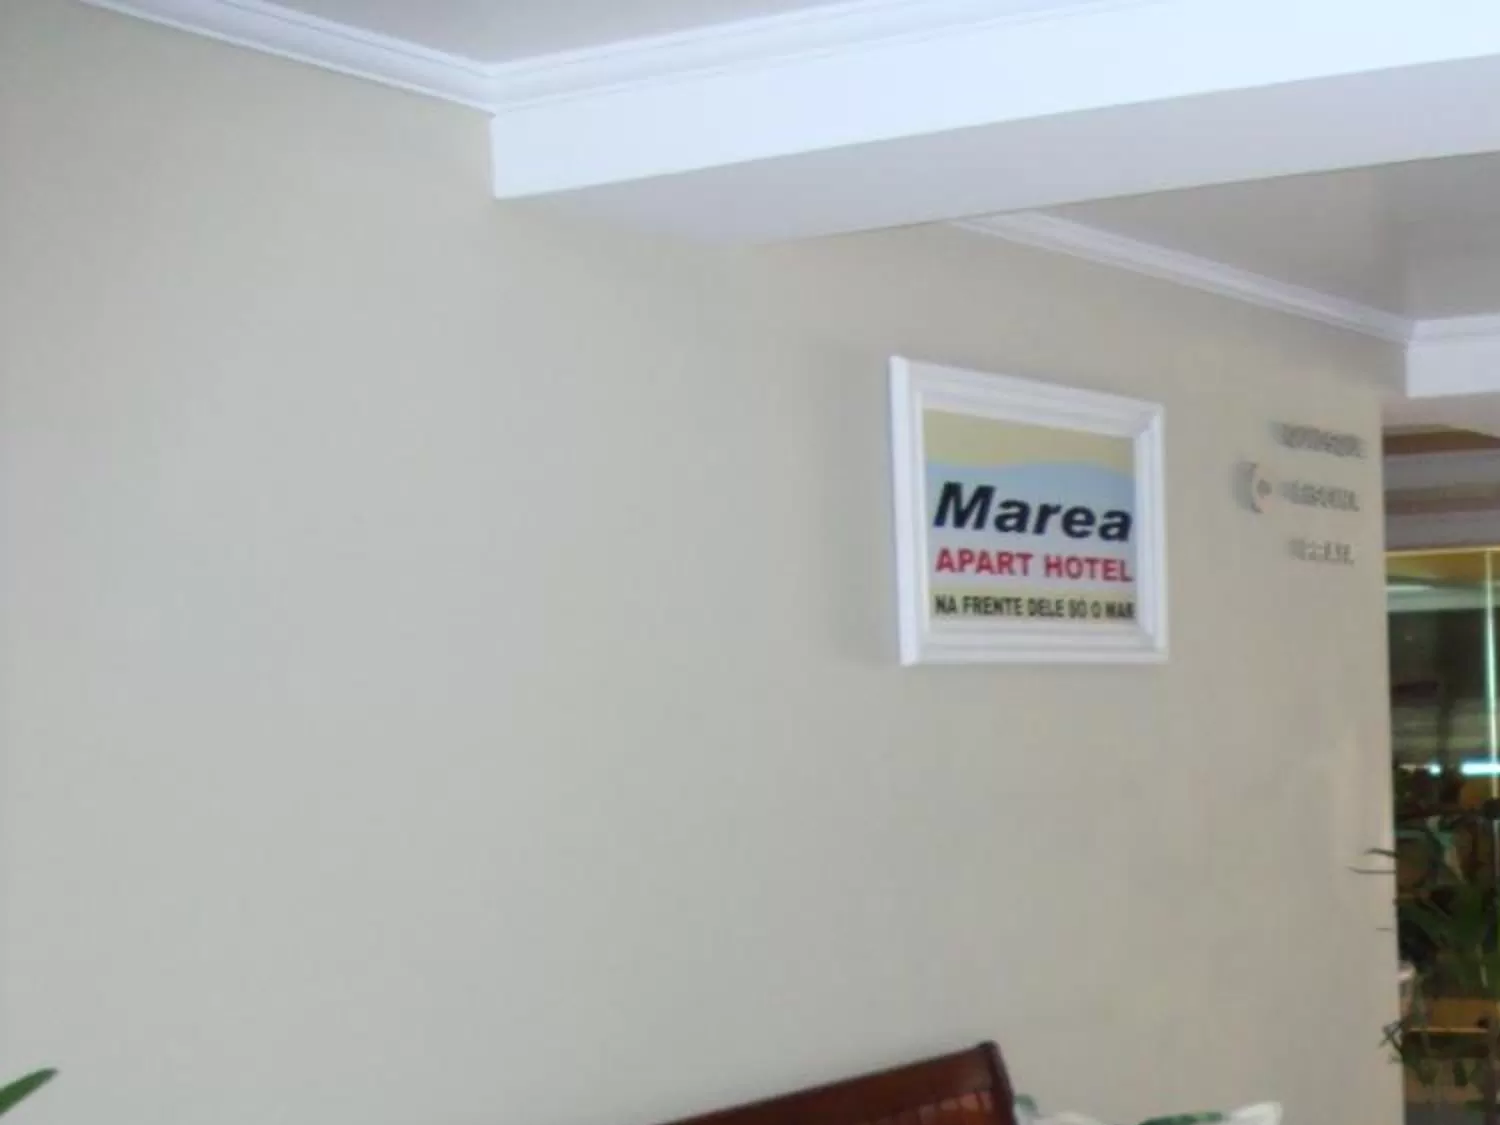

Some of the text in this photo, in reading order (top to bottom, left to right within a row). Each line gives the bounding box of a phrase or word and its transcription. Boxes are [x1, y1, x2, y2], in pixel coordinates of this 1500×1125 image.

[933, 480, 1132, 542] Marea
[935, 547, 1134, 583] APART HOTEL
[934, 594, 957, 615] NA
[961, 594, 1024, 617] FRENTE
